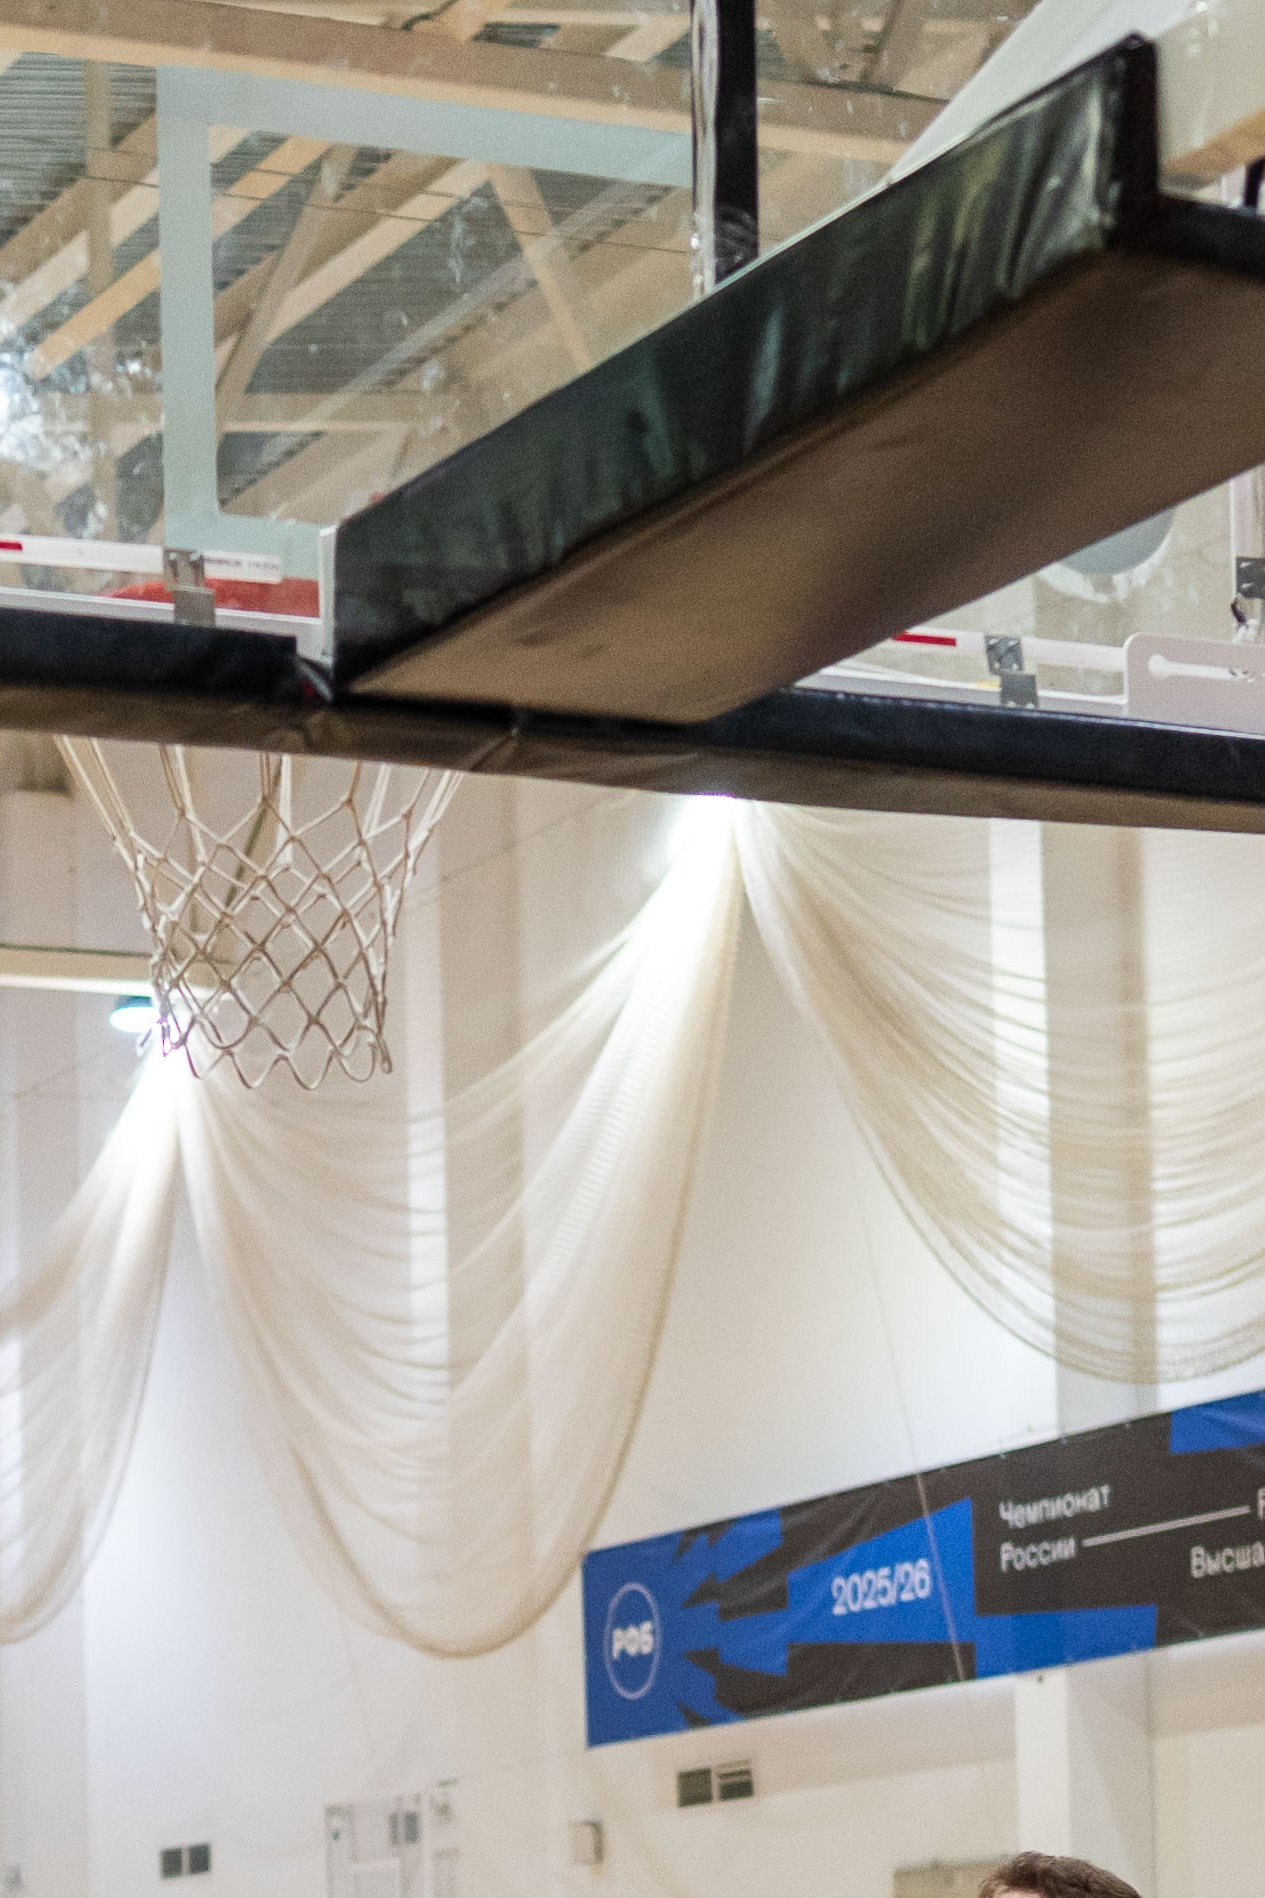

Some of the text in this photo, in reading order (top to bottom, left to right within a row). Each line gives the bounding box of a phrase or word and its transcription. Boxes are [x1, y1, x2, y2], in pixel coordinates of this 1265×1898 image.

[998, 1483, 1111, 1529] Чемпионат
[1000, 1537, 1076, 1573] России
[832, 1557, 930, 1616] 2025/26
[612, 1620, 654, 1660] РФБ
